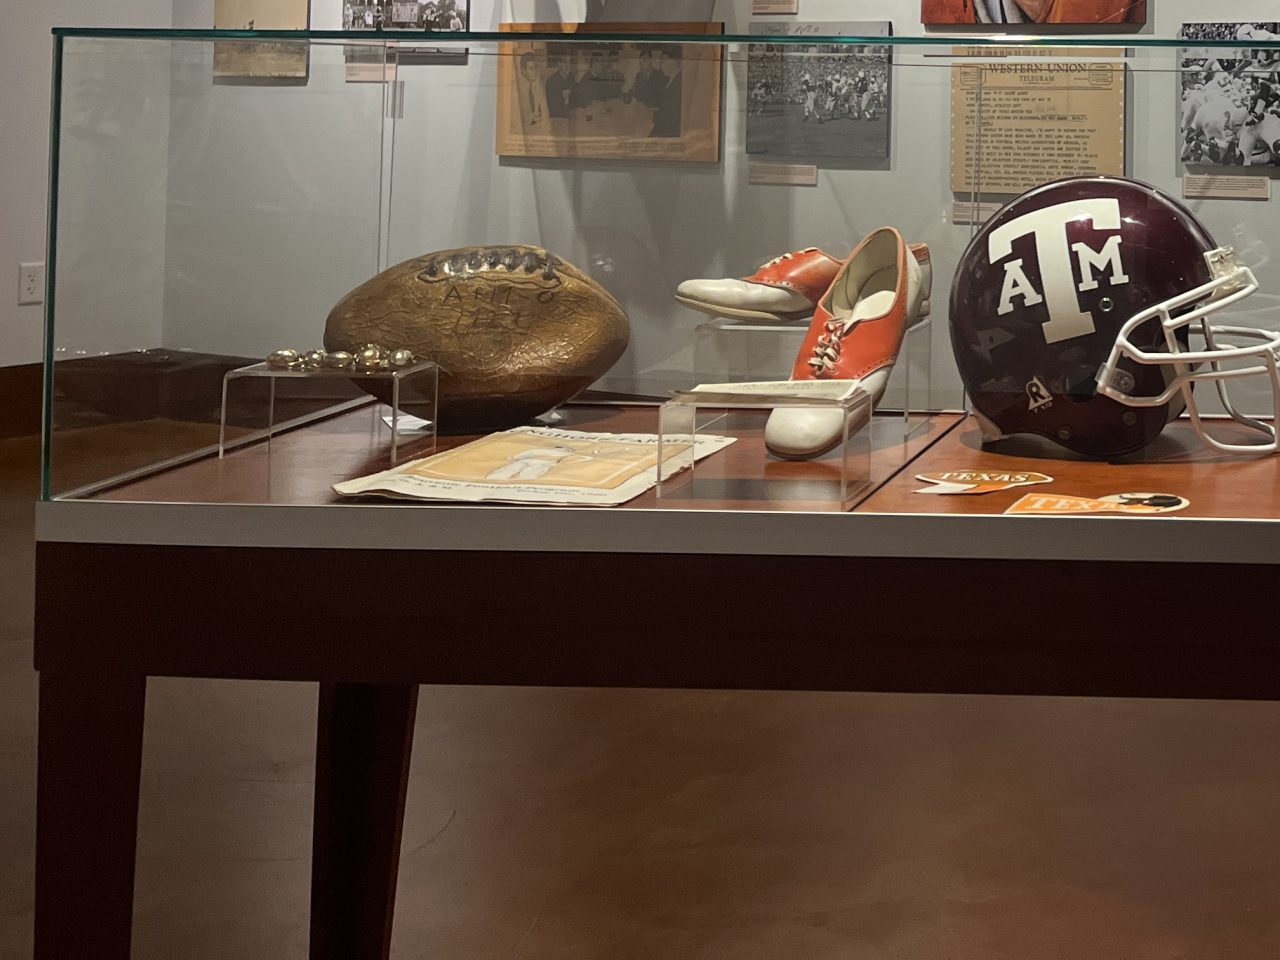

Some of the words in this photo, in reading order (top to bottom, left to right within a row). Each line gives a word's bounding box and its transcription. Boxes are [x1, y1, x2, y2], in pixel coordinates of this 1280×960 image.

[989, 63, 1056, 74] WESTERN
[1059, 63, 1088, 74] UNION
[938, 471, 1030, 483] TEXAS
